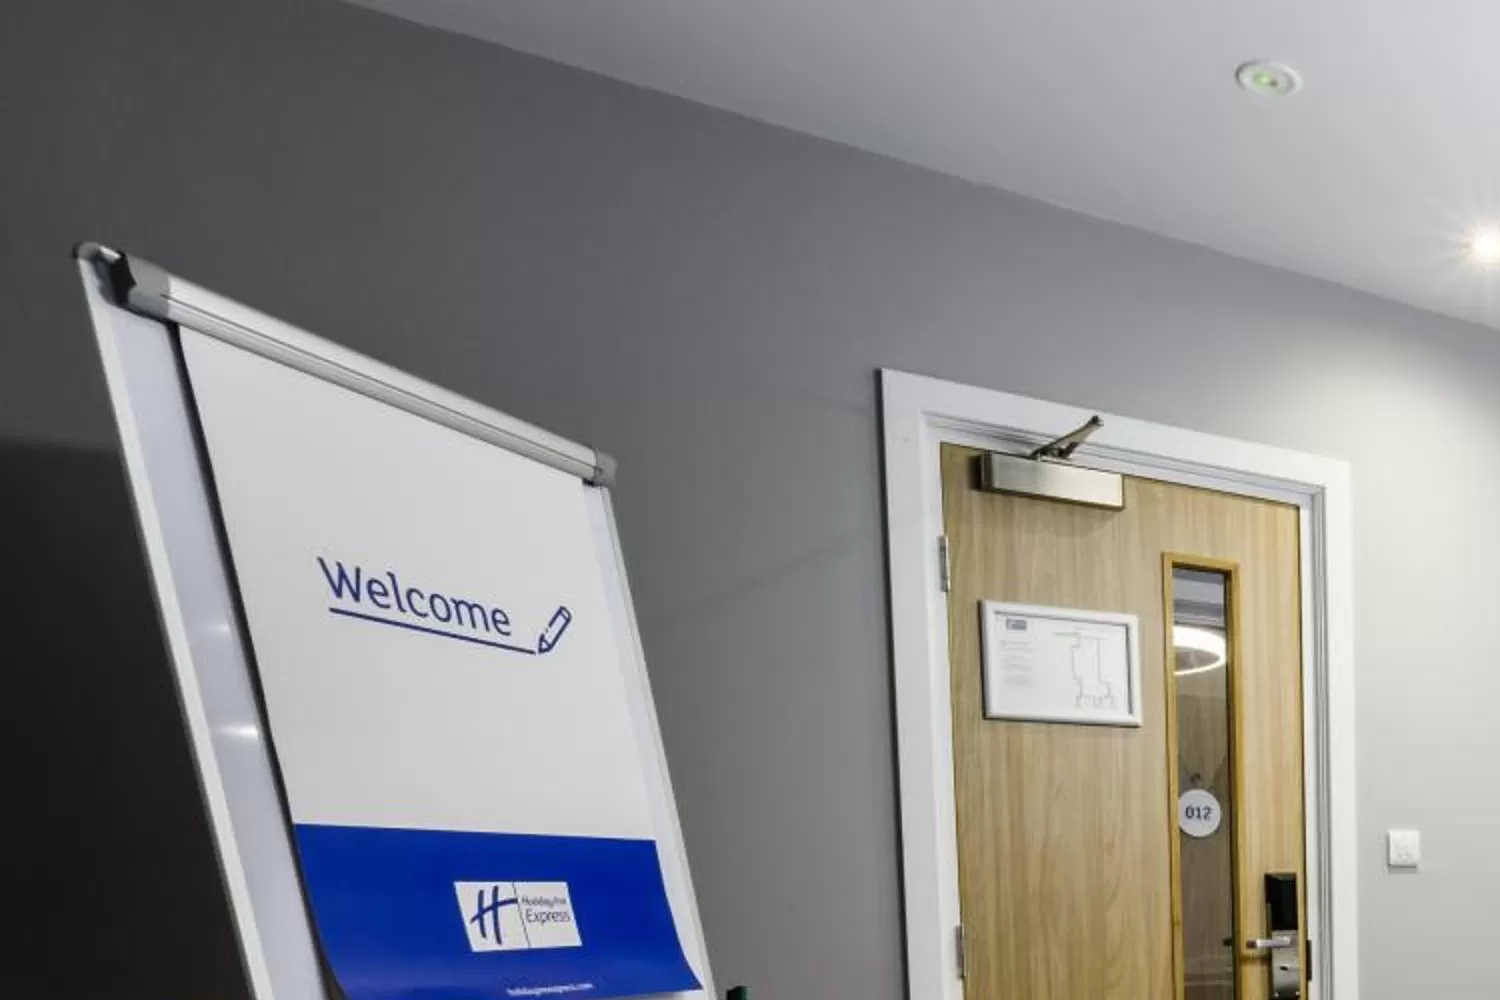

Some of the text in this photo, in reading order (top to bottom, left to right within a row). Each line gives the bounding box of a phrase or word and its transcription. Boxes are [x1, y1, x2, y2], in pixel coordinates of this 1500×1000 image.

[317, 556, 512, 636] Welcome
[1185, 805, 1212, 821] 012
[525, 908, 571, 925] Express
